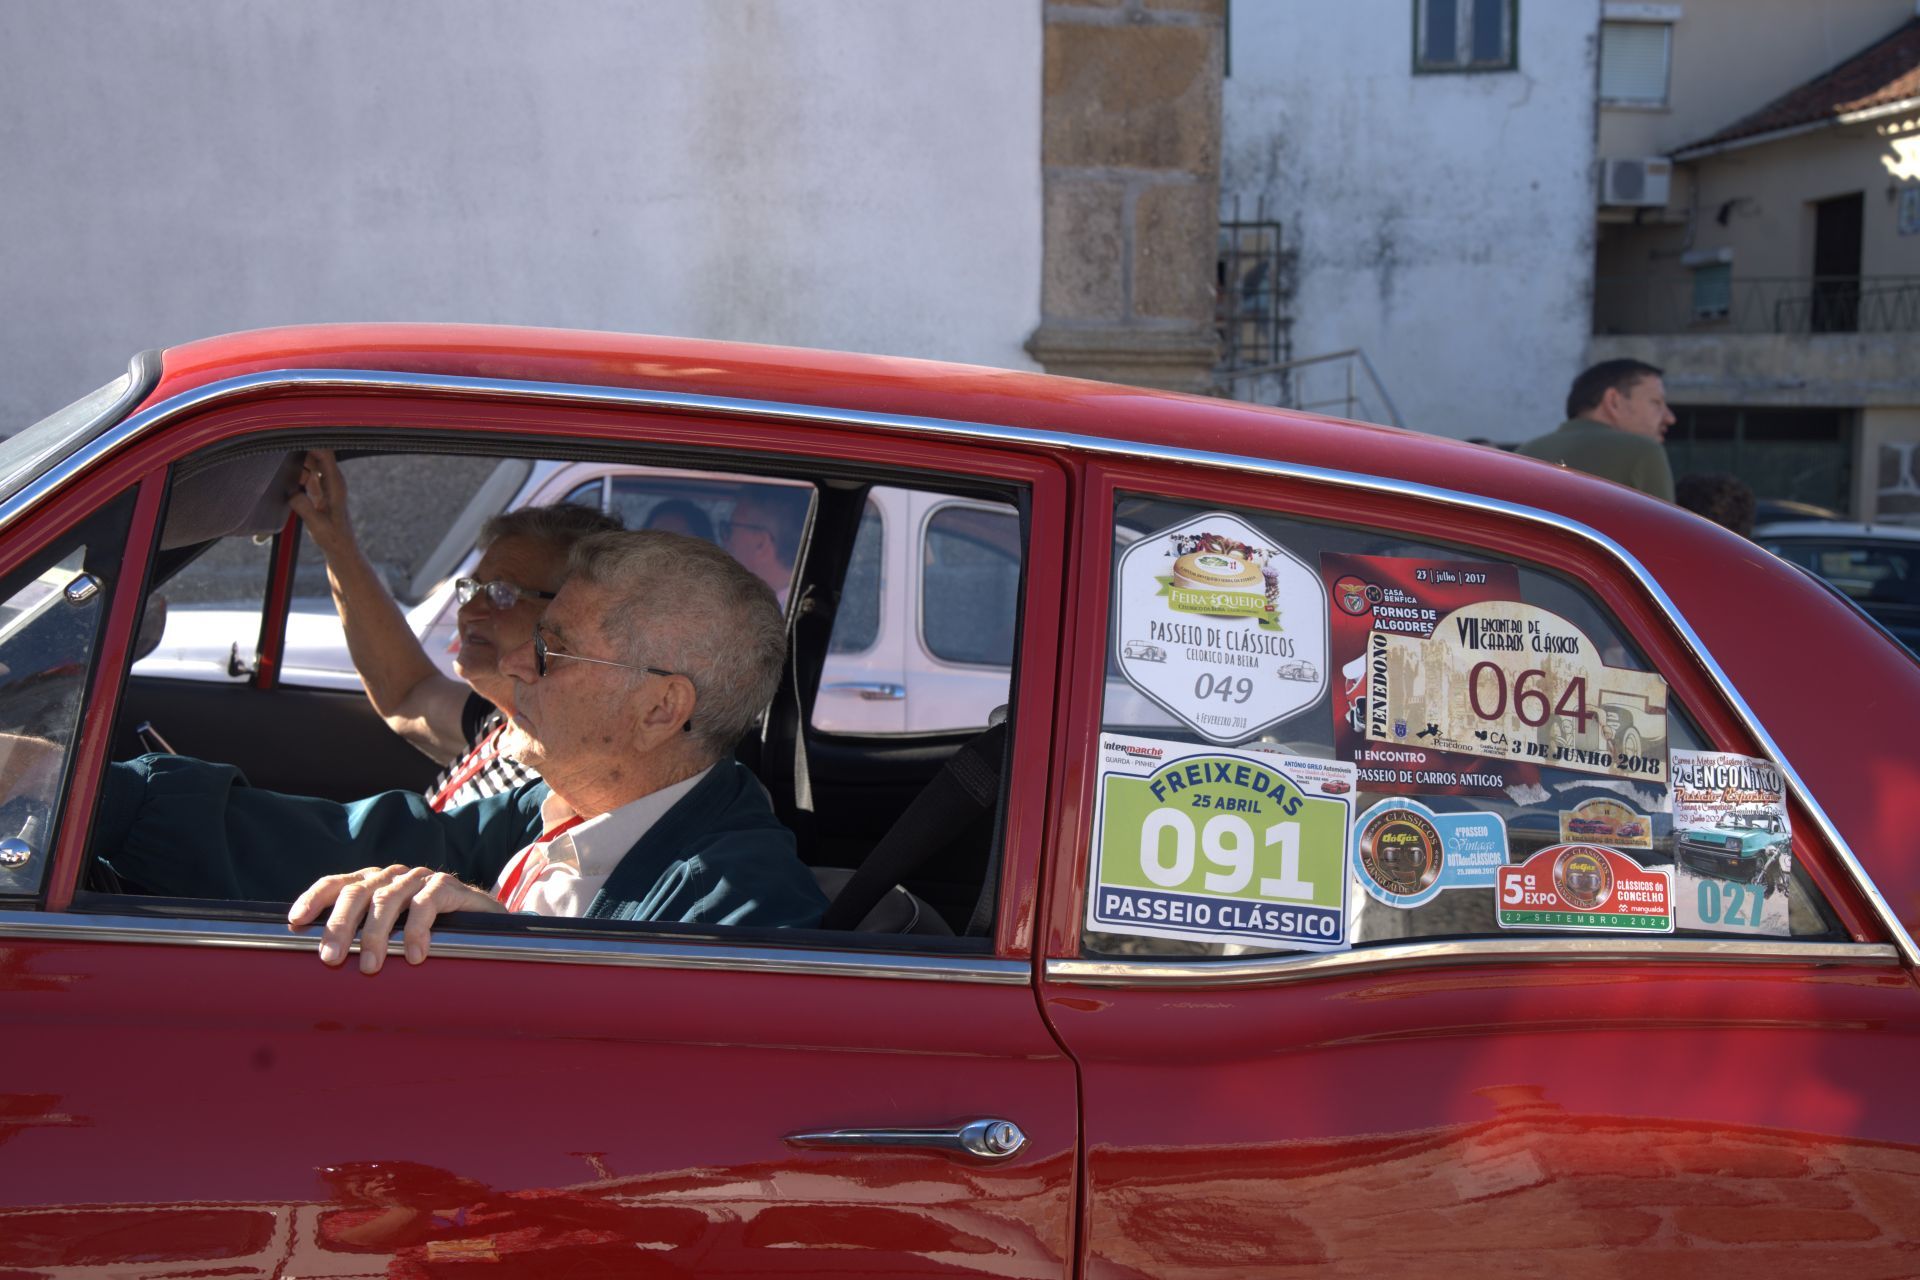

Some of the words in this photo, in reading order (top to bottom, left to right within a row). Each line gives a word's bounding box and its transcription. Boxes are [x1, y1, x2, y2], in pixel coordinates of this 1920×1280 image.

[1416, 569, 1427, 580] 23
[1436, 570, 1456, 583] julho
[1464, 573, 1486, 584] 2017
[1171, 590, 1207, 605] FEIRA
[1217, 594, 1265, 609] QUEIJO
[1383, 588, 1404, 597] CASA
[1384, 595, 1417, 604] BENFICA
[1373, 605, 1419, 619] FORNOS
[1421, 609, 1437, 620] DE
[1374, 618, 1434, 633] ALGODRES
[1456, 617, 1479, 650] VII
[1480, 618, 1523, 634] ENCONTRO
[1528, 620, 1540, 634] DE
[1150, 620, 1201, 647] PASSEIO
[1207, 628, 1221, 649] DE
[1226, 628, 1295, 658] CLÁSSICOS
[1480, 633, 1524, 651] CARROS
[1531, 632, 1580, 654] CLÁSSICOS
[1186, 648, 1222, 665] CELORICO
[1225, 653, 1235, 667] DA
[1237, 655, 1259, 668] BEIRA
[1194, 672, 1254, 704] 049
[1372, 634, 1388, 739] PENEDONO
[1469, 660, 1593, 735] 064
[1200, 712, 1232, 727] FEVEREIRO
[1232, 715, 1248, 729] 2018
[1433, 738, 1473, 751] Penedono
[1490, 731, 1508, 745] CA
[1105, 756, 1130, 765] GUARDA
[1134, 759, 1156, 768] PINHEL
[1354, 749, 1362, 760] II
[1365, 750, 1427, 763] ENCONTRO
[1511, 740, 1522, 754] 3
[1526, 741, 1549, 757] DE
[1552, 746, 1612, 767] JUNHO
[1616, 753, 1660, 775] 2018
[1284, 760, 1307, 769] ANTÓNIO
[1307, 763, 1323, 771] GRILO
[1356, 768, 1397, 782] PASSEIO
[1400, 770, 1413, 783] DE
[1415, 771, 1457, 785] CARROS
[1459, 773, 1503, 787] ANTIGOS
[1149, 762, 1304, 817] FREIXEDAS
[1191, 793, 1211, 808] 25
[1214, 796, 1262, 814] ABRIL
[1140, 807, 1314, 901] 091
[1617, 879, 1654, 891] CLÁSSICOS
[1655, 881, 1664, 892] do
[1525, 893, 1557, 905] EXPO
[1617, 890, 1664, 903] CONCELHO
[1697, 879, 1765, 927] 027
[1105, 893, 1211, 925] PASSEIO
[1218, 904, 1336, 937] CLÁSSICO
[1631, 905, 1664, 914] mangualde
